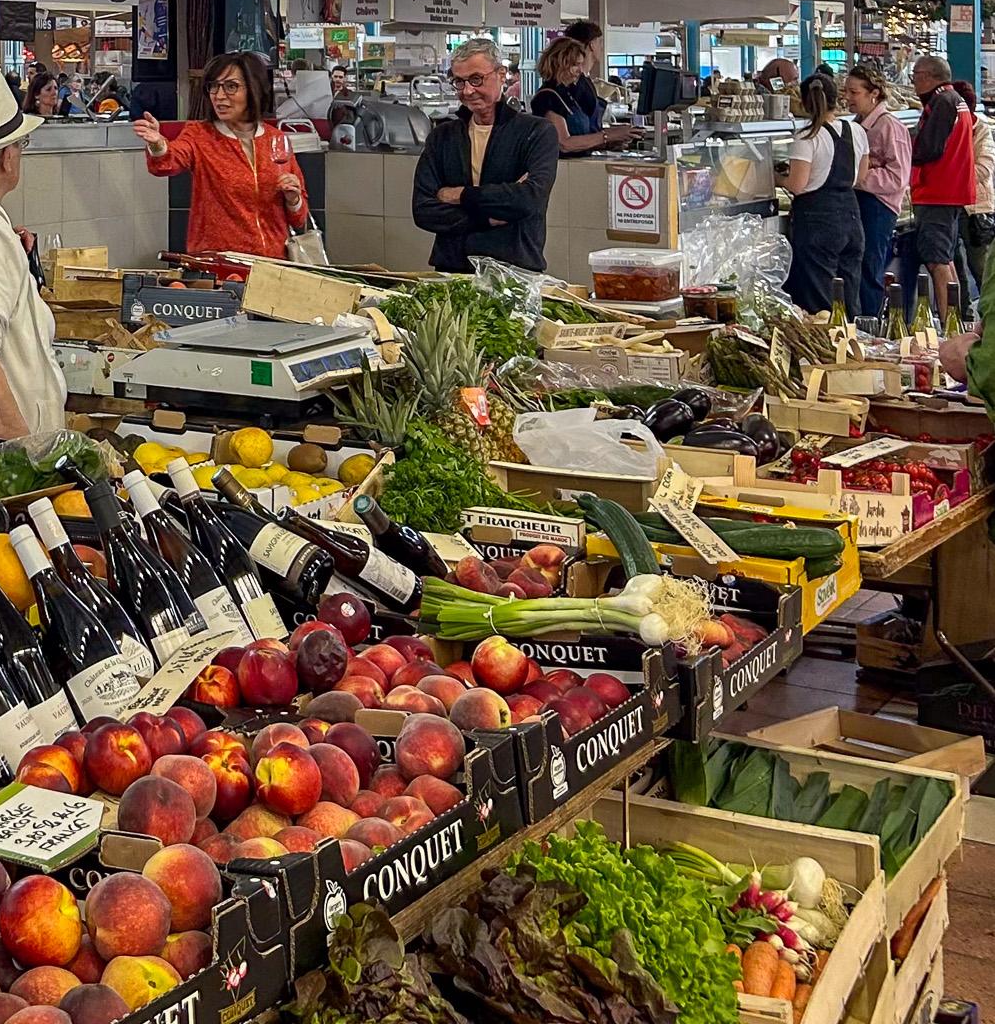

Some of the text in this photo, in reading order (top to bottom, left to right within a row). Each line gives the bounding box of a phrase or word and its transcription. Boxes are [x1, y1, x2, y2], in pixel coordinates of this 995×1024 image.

[153, 303, 223, 319] CONQUET
[478, 516, 562, 534] FRAICHEUR
[512, 643, 607, 664] ONQUET
[730, 641, 778, 698] CONQUET
[576, 705, 644, 773] CONQUET
[39, 818, 90, 851] FRANCE
[363, 818, 464, 902] CONQUET
